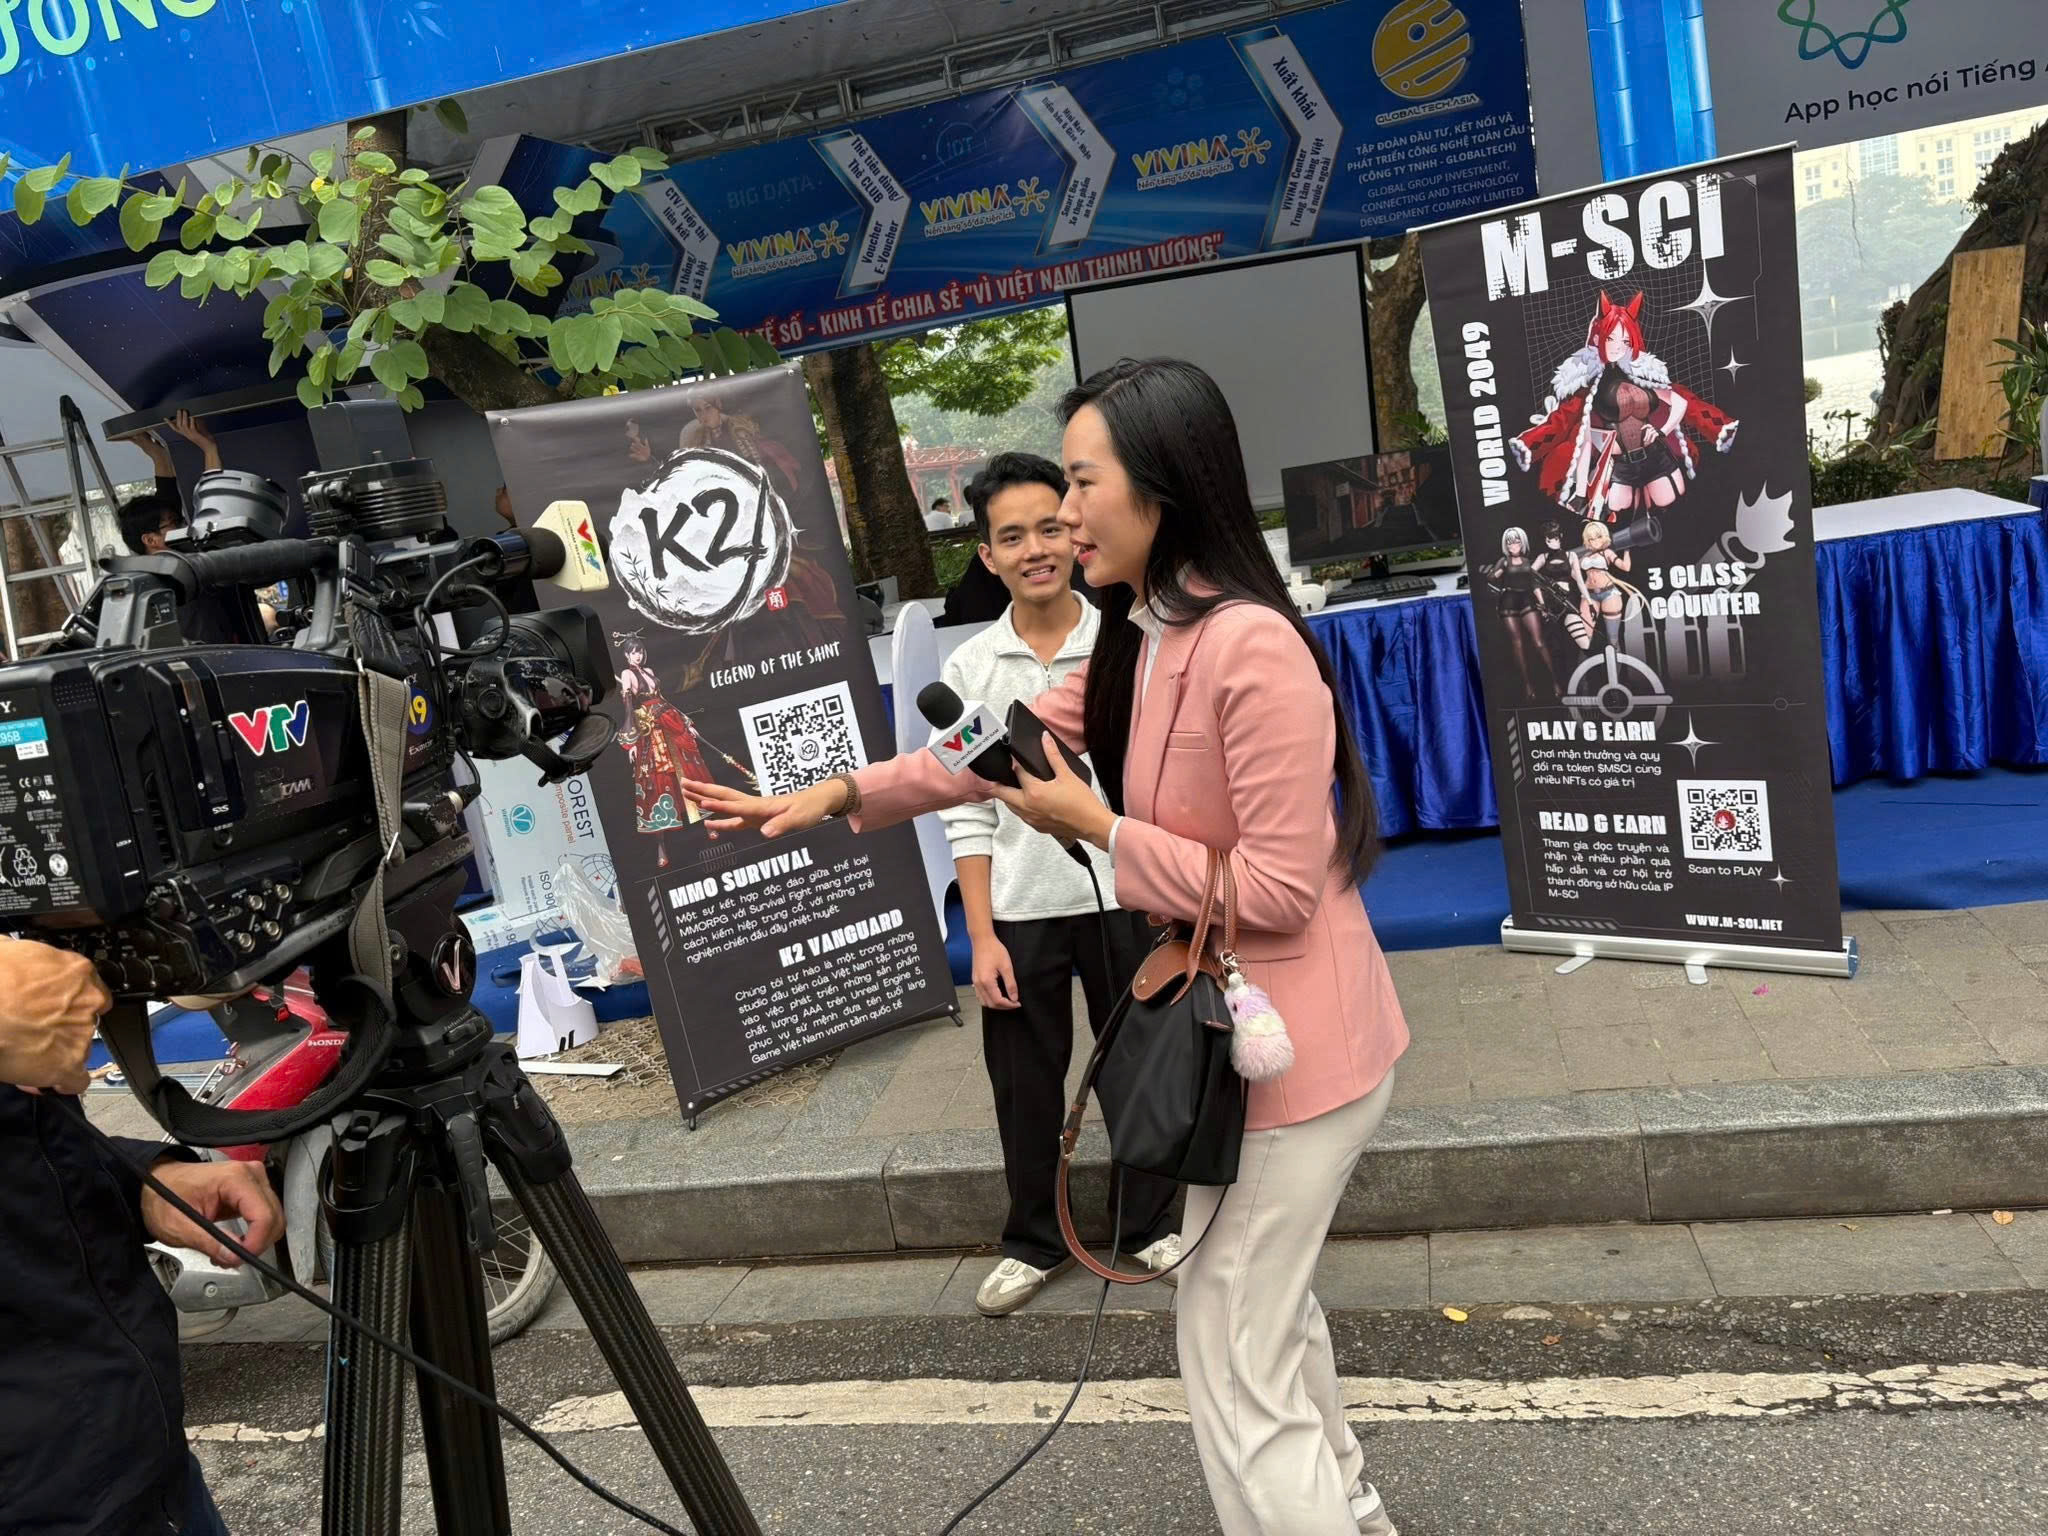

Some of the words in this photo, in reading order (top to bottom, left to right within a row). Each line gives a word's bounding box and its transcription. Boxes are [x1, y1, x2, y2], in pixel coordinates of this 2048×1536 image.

[1272, 56, 1298, 89] Xuất
[1291, 85, 1318, 120] khẩu
[1784, 98, 1840, 124] App
[1848, 87, 1898, 111] học
[1907, 71, 1949, 99] nói
[1956, 58, 2036, 87] Tiếng
[864, 154, 881, 176] tiêu
[1132, 136, 1230, 179] VIVINA
[1358, 168, 1392, 184] (CÔNG
[1393, 165, 1406, 175] TY
[1407, 158, 1437, 172] TNHH
[1445, 141, 1516, 164] GLOBALTECH)
[861, 174, 885, 204] CLUB
[1361, 191, 1426, 213] CONNECTING
[1427, 187, 1450, 199] AND
[1451, 172, 1519, 194] TECHNOLOGY
[1367, 183, 1406, 198] GLOBAL
[1407, 174, 1443, 189] GROUP
[1444, 160, 1510, 182] INVESTMENT,
[919, 185, 1012, 224] VIVINA
[1359, 205, 1429, 228] DEVELOPMENT
[1432, 195, 1481, 212] COMPANY
[1483, 186, 1524, 202] LIMITED
[727, 228, 813, 266] VIVINA
[861, 220, 883, 264] Voucher
[874, 219, 899, 275] E-Voucher
[1480, 172, 1725, 301] M-SCI
[779, 313, 802, 342] SỐ
[820, 308, 863, 334] KINH
[891, 294, 935, 320] CHIA
[939, 282, 961, 310] SẺ
[964, 276, 992, 303] "VÌ
[996, 269, 1033, 300] VIỆT
[1040, 264, 1081, 291] NAM
[1462, 321, 1497, 398] 2049
[1473, 404, 1511, 507] WORLD
[1647, 567, 1663, 590] 3
[1669, 561, 1747, 588] CLASS
[1650, 591, 1761, 619] COUNTER
[710, 664, 755, 688] LEGEND
[760, 657, 775, 674] OF
[779, 650, 803, 670] THE
[806, 641, 840, 664] SAINT
[228, 700, 310, 757] VTV
[942, 715, 982, 752] VTV
[1527, 720, 1577, 741] PLAY
[1601, 721, 1656, 741] EARN
[1530, 749, 1555, 759] Chơi
[1557, 749, 1581, 760] nhận
[1583, 749, 1621, 762] thưởng
[1623, 750, 1637, 760] và
[1639, 752, 1660, 762] quy
[1532, 760, 1549, 771] đổi
[1566, 763, 1594, 772] token
[1597, 763, 1632, 773] $MSCI
[1634, 764, 1661, 776] cùng
[1534, 774, 1561, 784] nhiều
[1562, 775, 1587, 786] NFTs
[1603, 777, 1620, 788] giá
[1621, 777, 1635, 788] trị
[1539, 811, 1589, 832] READ
[1613, 814, 1666, 834] EARN
[1542, 838, 1570, 848] Tham
[1573, 840, 1589, 851] gia
[1592, 841, 1613, 852] đọc
[1617, 842, 1652, 854] truyện
[1655, 843, 1670, 853] và
[539, 870, 552, 891] ISO
[668, 877, 718, 909] MMO
[721, 847, 813, 892] SURVIVAL
[675, 911, 698, 924] Một
[702, 904, 715, 916] sự
[719, 898, 736, 910] kết
[739, 892, 759, 903] hợp
[763, 884, 782, 896] độc
[786, 877, 805, 888] đáo
[808, 868, 830, 883] giữa
[833, 859, 849, 872] thể
[853, 854, 869, 866] loại
[1688, 863, 1716, 874] Scan
[1717, 866, 1731, 875] to
[1733, 866, 1762, 876] PLAY
[679, 914, 729, 937] MMORPG
[731, 907, 746, 919] với
[748, 894, 786, 914] Survival
[788, 887, 812, 901] Fight
[815, 878, 841, 892] mang
[843, 868, 872, 884] phong
[1548, 888, 1579, 899] M-SCI
[778, 942, 806, 967] K2
[807, 909, 903, 956] VANGUARD
[735, 985, 767, 1001] Chúng
[770, 976, 784, 989] tôi
[787, 972, 799, 983] tự
[802, 965, 821, 977] hào
[836, 952, 856, 965] một
[858, 942, 884, 957] trong
[887, 931, 914, 946] những
[751, 1047, 781, 1064] Game
[781, 1039, 802, 1052] Việt
[802, 1031, 824, 1044] Nam
[825, 1022, 849, 1036] vươn
[849, 1014, 868, 1026] tầm
[869, 1004, 891, 1019] quốc
[892, 998, 902, 1010] tế
